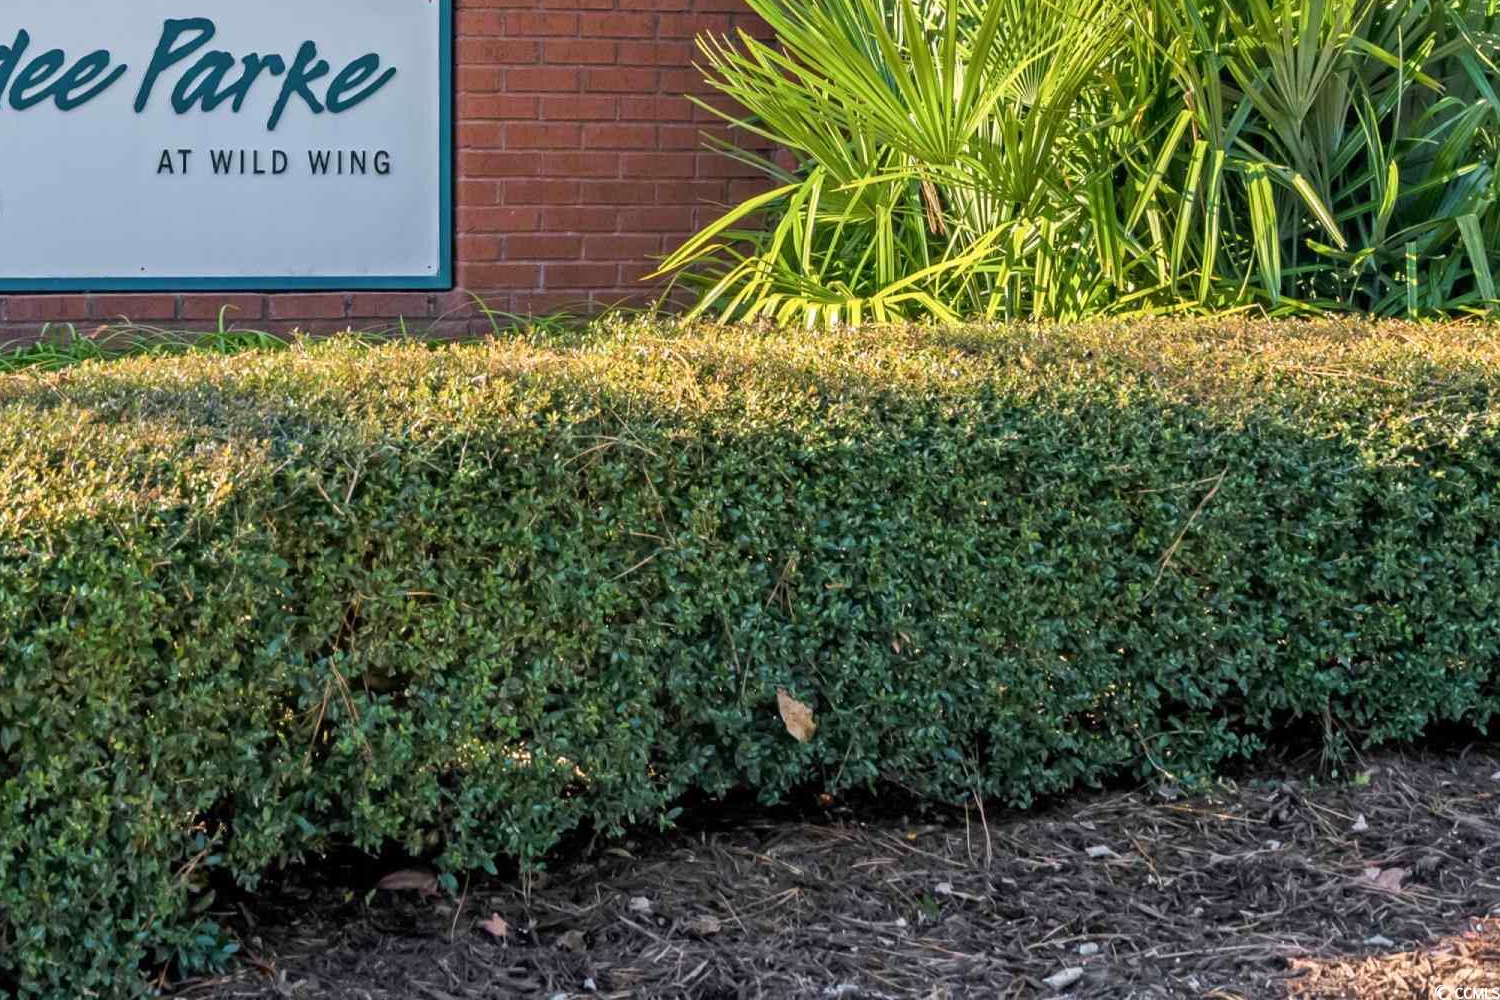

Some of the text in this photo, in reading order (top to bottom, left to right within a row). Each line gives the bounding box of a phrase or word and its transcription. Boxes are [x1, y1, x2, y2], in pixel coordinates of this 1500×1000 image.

[133, 17, 398, 131] Parke
[156, 149, 391, 176] AT WILD WING
